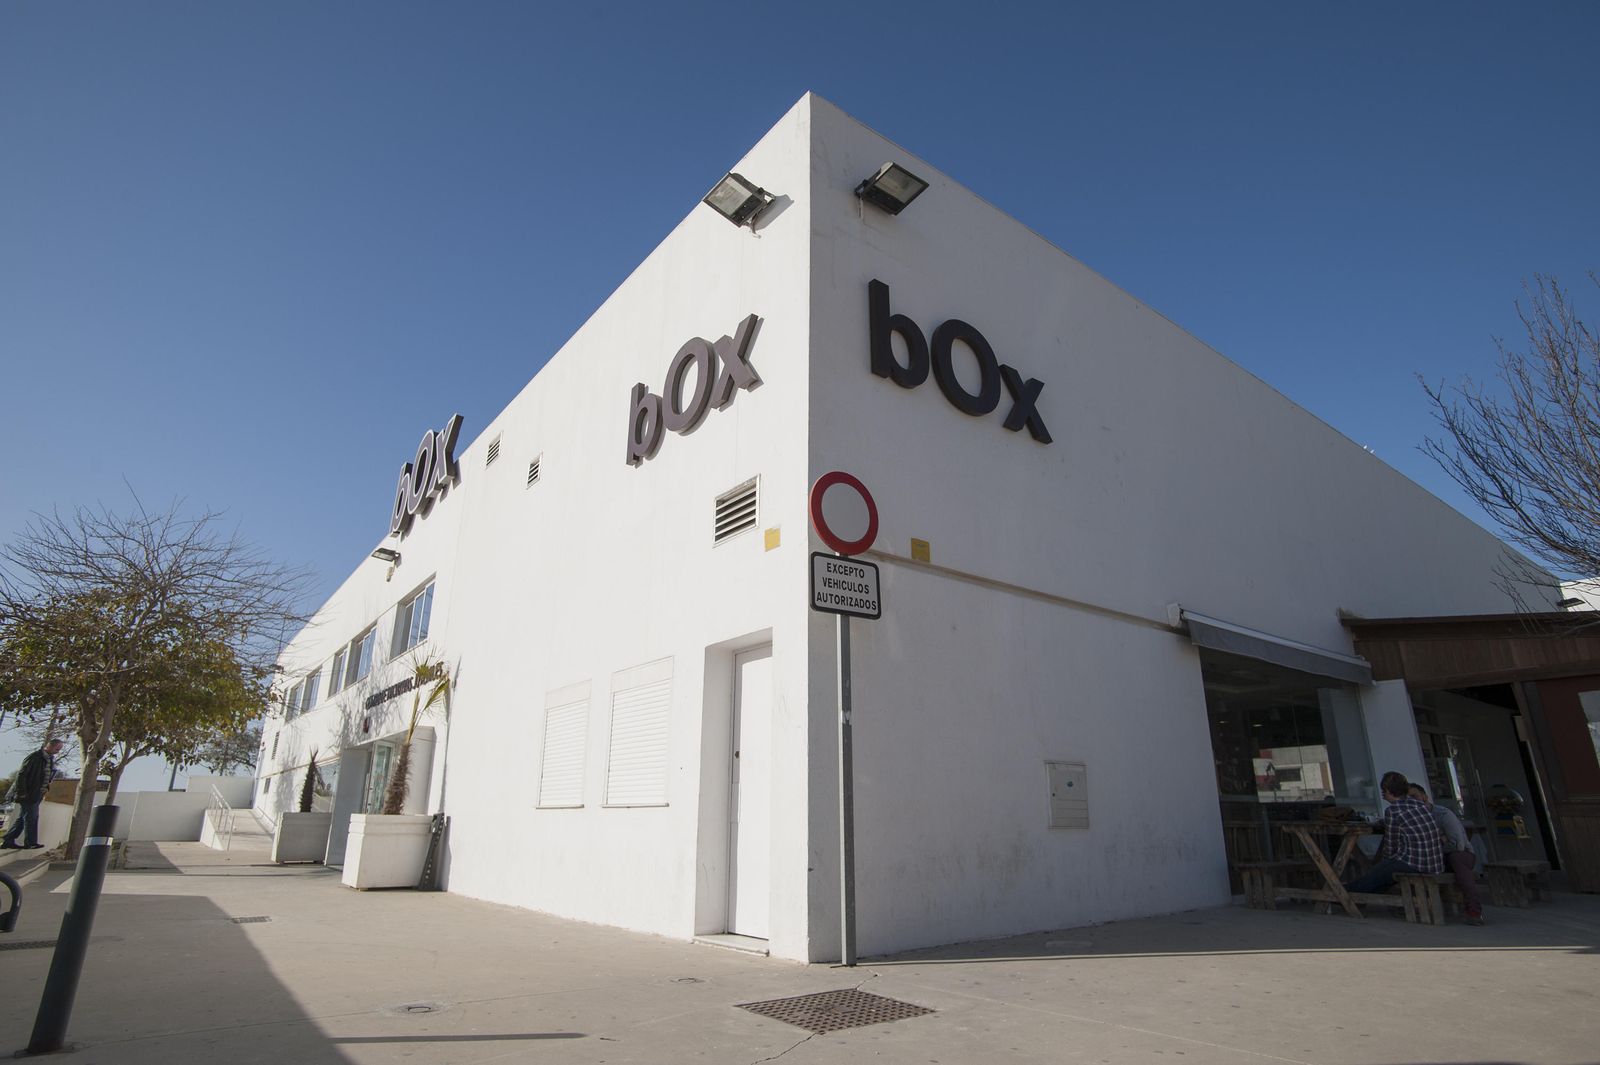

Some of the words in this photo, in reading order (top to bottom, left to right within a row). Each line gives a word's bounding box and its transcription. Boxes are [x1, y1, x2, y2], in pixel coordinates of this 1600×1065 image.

[826, 562, 865, 579] EXCEPTO
[822, 576, 870, 595] VEHICULOS
[816, 592, 877, 611] AUTORIZADOS
